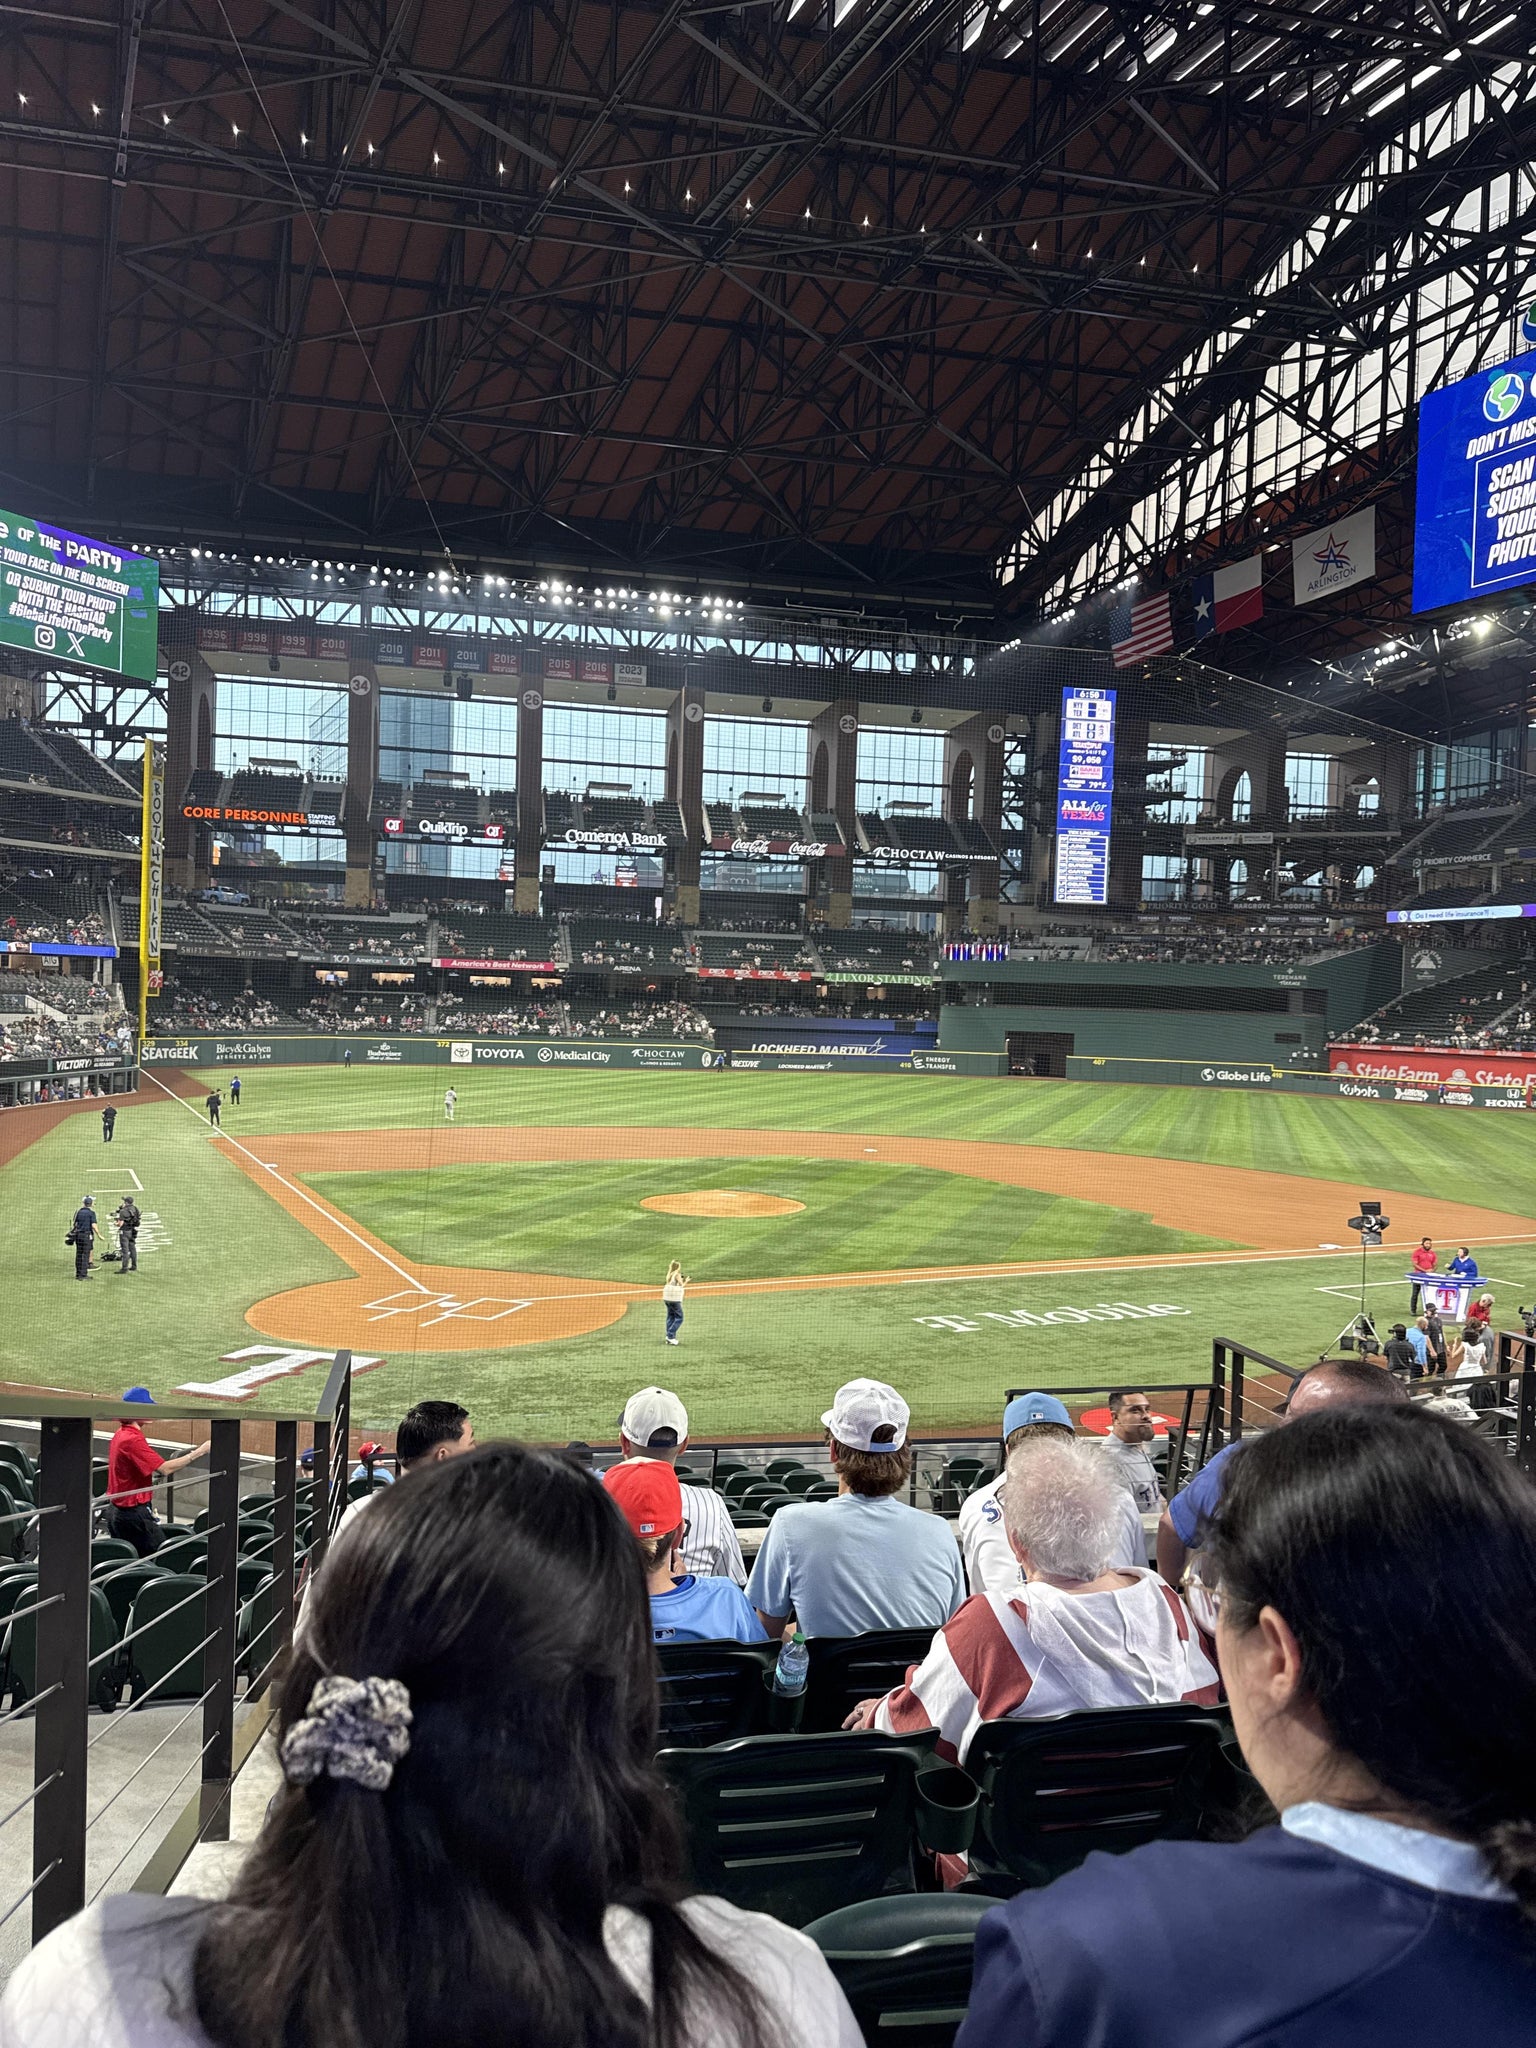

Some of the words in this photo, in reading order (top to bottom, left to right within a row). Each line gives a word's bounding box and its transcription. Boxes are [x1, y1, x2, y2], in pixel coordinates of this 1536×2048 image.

[1466, 426, 1509, 460] DON'T
[1488, 455, 1536, 493] SCAN
[1486, 480, 1536, 518] SUBM
[18, 528, 34, 542] OF
[38, 532, 62, 551] THE
[66, 540, 122, 573] PARTY
[3, 548, 27, 564] YOUR
[28, 555, 49, 571] FACE
[50, 562, 63, 575] ON
[64, 566, 80, 581] THE
[80, 572, 94, 586] BIG
[95, 577, 130, 596] SCREEN!
[1307, 566, 1356, 592] ARLINGTON
[6, 570, 22, 587] OR
[22, 576, 61, 597] SUBMIT
[61, 586, 85, 605] YOUR
[86, 593, 116, 614] PHOTO
[18, 589, 44, 607] WITH
[45, 597, 64, 613] THE
[64, 601, 106, 625] HASHTAG
[203, 628, 227, 640] 1996
[243, 632, 267, 643] 1998
[282, 635, 306, 646] 1999
[321, 639, 345, 650] 2010
[379, 643, 403, 655] 2010
[420, 647, 441, 658] 2011
[456, 650, 477, 661] 2011
[493, 654, 516, 665] 2012
[548, 659, 571, 669] 2015
[172, 665, 188, 678] 42
[585, 662, 607, 673] 2016
[619, 664, 642, 675] 2023
[353, 679, 368, 690] 34
[525, 694, 540, 705] 26
[1080, 690, 1100, 698] 6:50
[691, 708, 698, 719] 7
[842, 718, 855, 730] 29
[991, 729, 1001, 739] 10
[183, 806, 221, 820] CORE
[224, 809, 307, 824] PERSONNEL
[1061, 800, 1090, 811] ALL
[1087, 801, 1107, 817] for
[1061, 810, 1105, 821] TEXAS
[385, 818, 401, 832] QT
[419, 819, 468, 837] QuikTrip
[485, 825, 502, 838] QT
[632, 833, 667, 846] Bank
[880, 846, 945, 861] CHOCTAW
[1424, 857, 1452, 866] PRIORITY
[1454, 853, 1491, 863] COMMERCE
[150, 869, 160, 953] CHIKIN
[1149, 902, 1189, 910] PRIORITY
[1192, 902, 1217, 910] GOLD
[451, 959, 492, 967] America's
[511, 962, 545, 970] Network
[836, 973, 875, 983] LUXOR
[877, 975, 931, 985] STAFFING
[141, 1045, 199, 1060] SEATGEEK
[475, 1048, 525, 1059] TOYOTA
[632, 1048, 685, 1058] CHOCTAW
[751, 1043, 817, 1054] LOCKHEED
[819, 1045, 869, 1055] MARTIN
[553, 1050, 591, 1061] Medical
[591, 1051, 611, 1063] City
[1216, 1070, 1247, 1082] Globe
[1250, 1071, 1271, 1083] Life
[1356, 1062, 1398, 1079] State
[1398, 1065, 1439, 1083] Farm
[1475, 1070, 1527, 1087] State
[1339, 1083, 1380, 1098] Kubota
[1437, 1288, 1457, 1310] T
